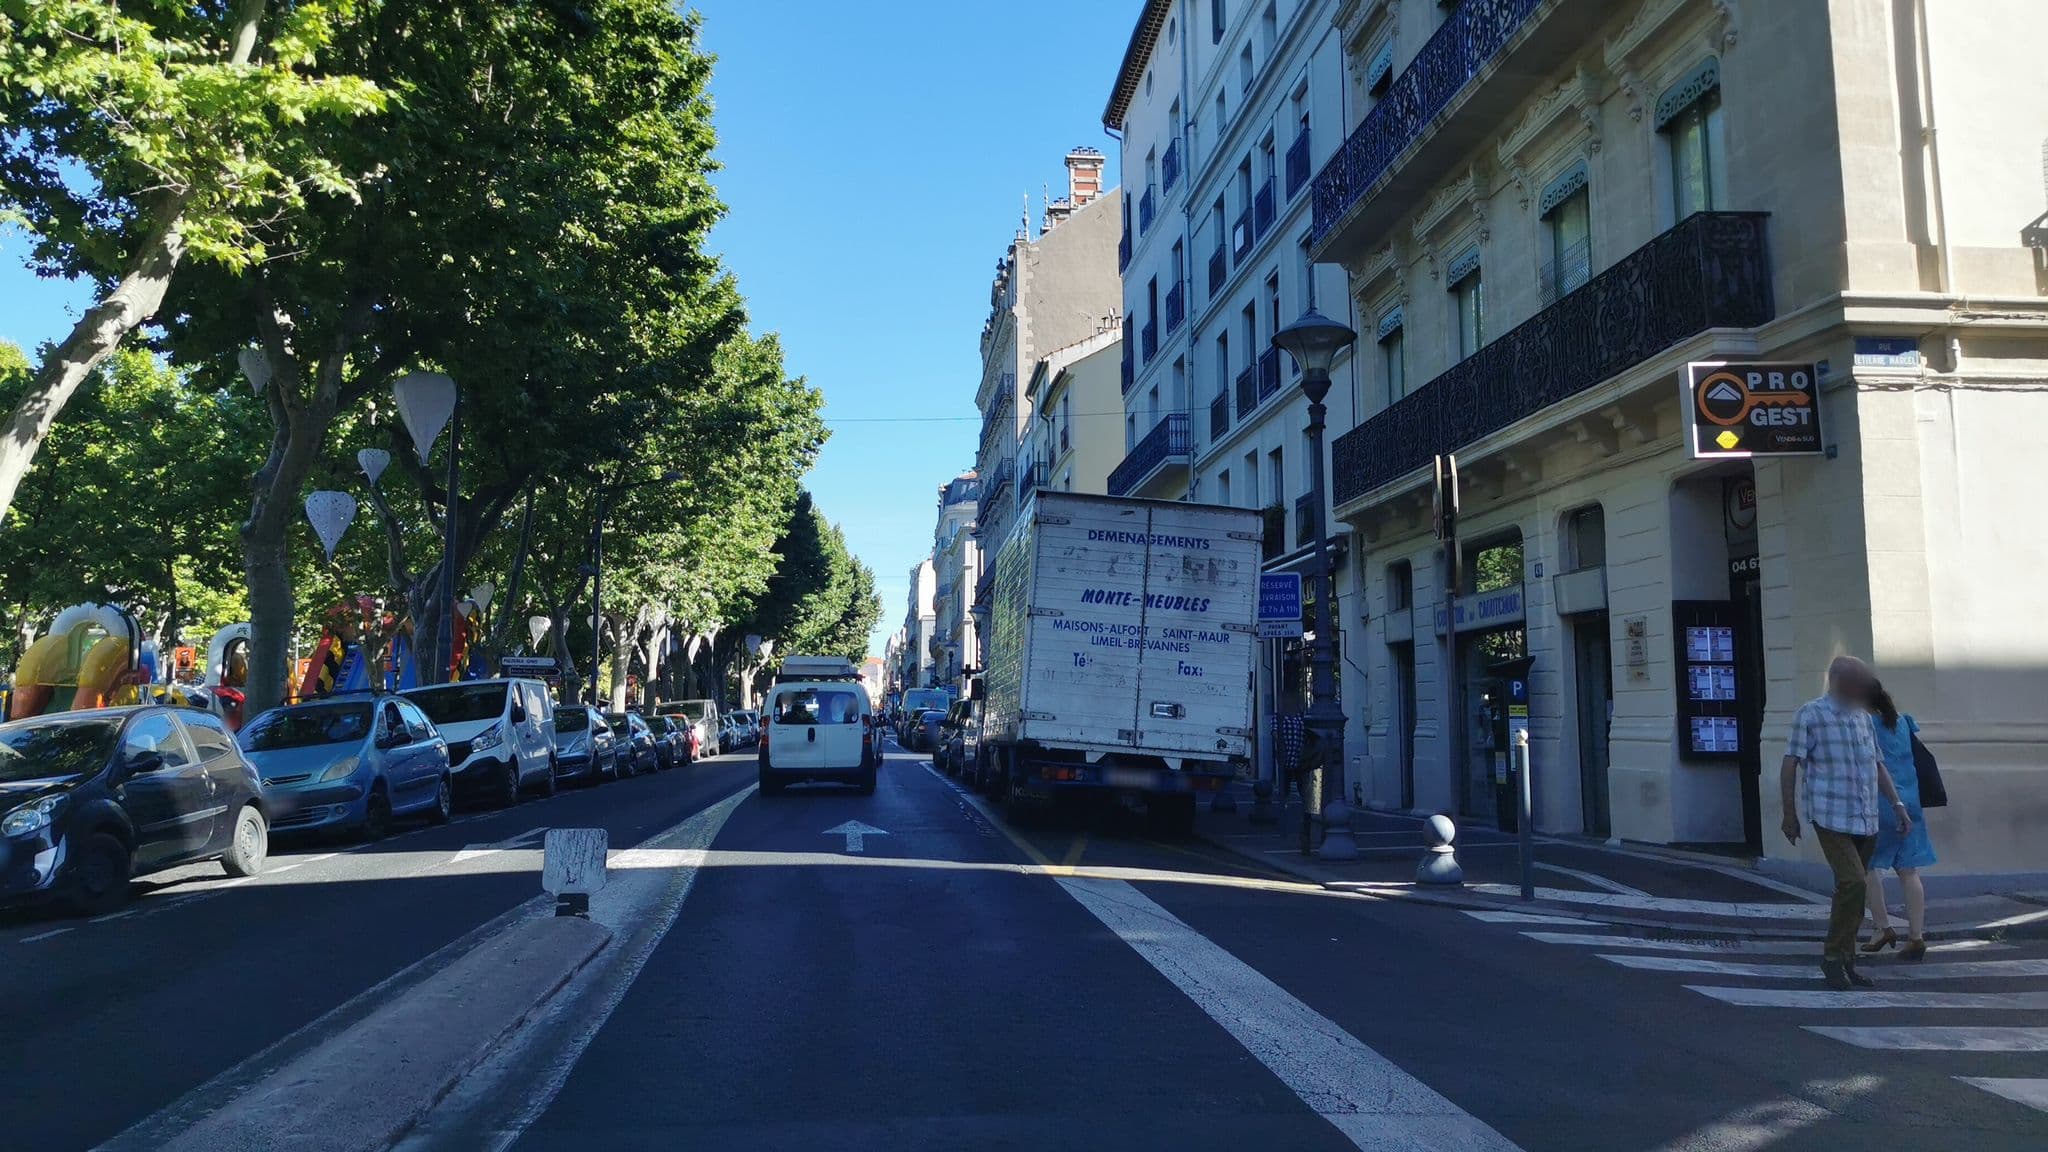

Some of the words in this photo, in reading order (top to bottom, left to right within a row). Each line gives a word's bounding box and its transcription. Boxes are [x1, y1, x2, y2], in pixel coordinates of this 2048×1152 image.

[1878, 343, 1892, 351] RUE
[1746, 371, 1809, 390] PRO
[1750, 407, 1811, 426] GEST
[1088, 529, 1210, 550] DEMENAGEMENTS
[1732, 559, 1747, 573] 04
[1080, 588, 1211, 613] MONTE-MEUBLES
[1053, 619, 1150, 636] MAISONS-ALFORT
[1162, 627, 1230, 645] SAINT-MAUR
[1090, 635, 1191, 653] LIMEIL-BREVANNES
[1177, 661, 1203, 677] Fax:
[1513, 680, 1522, 696] P
